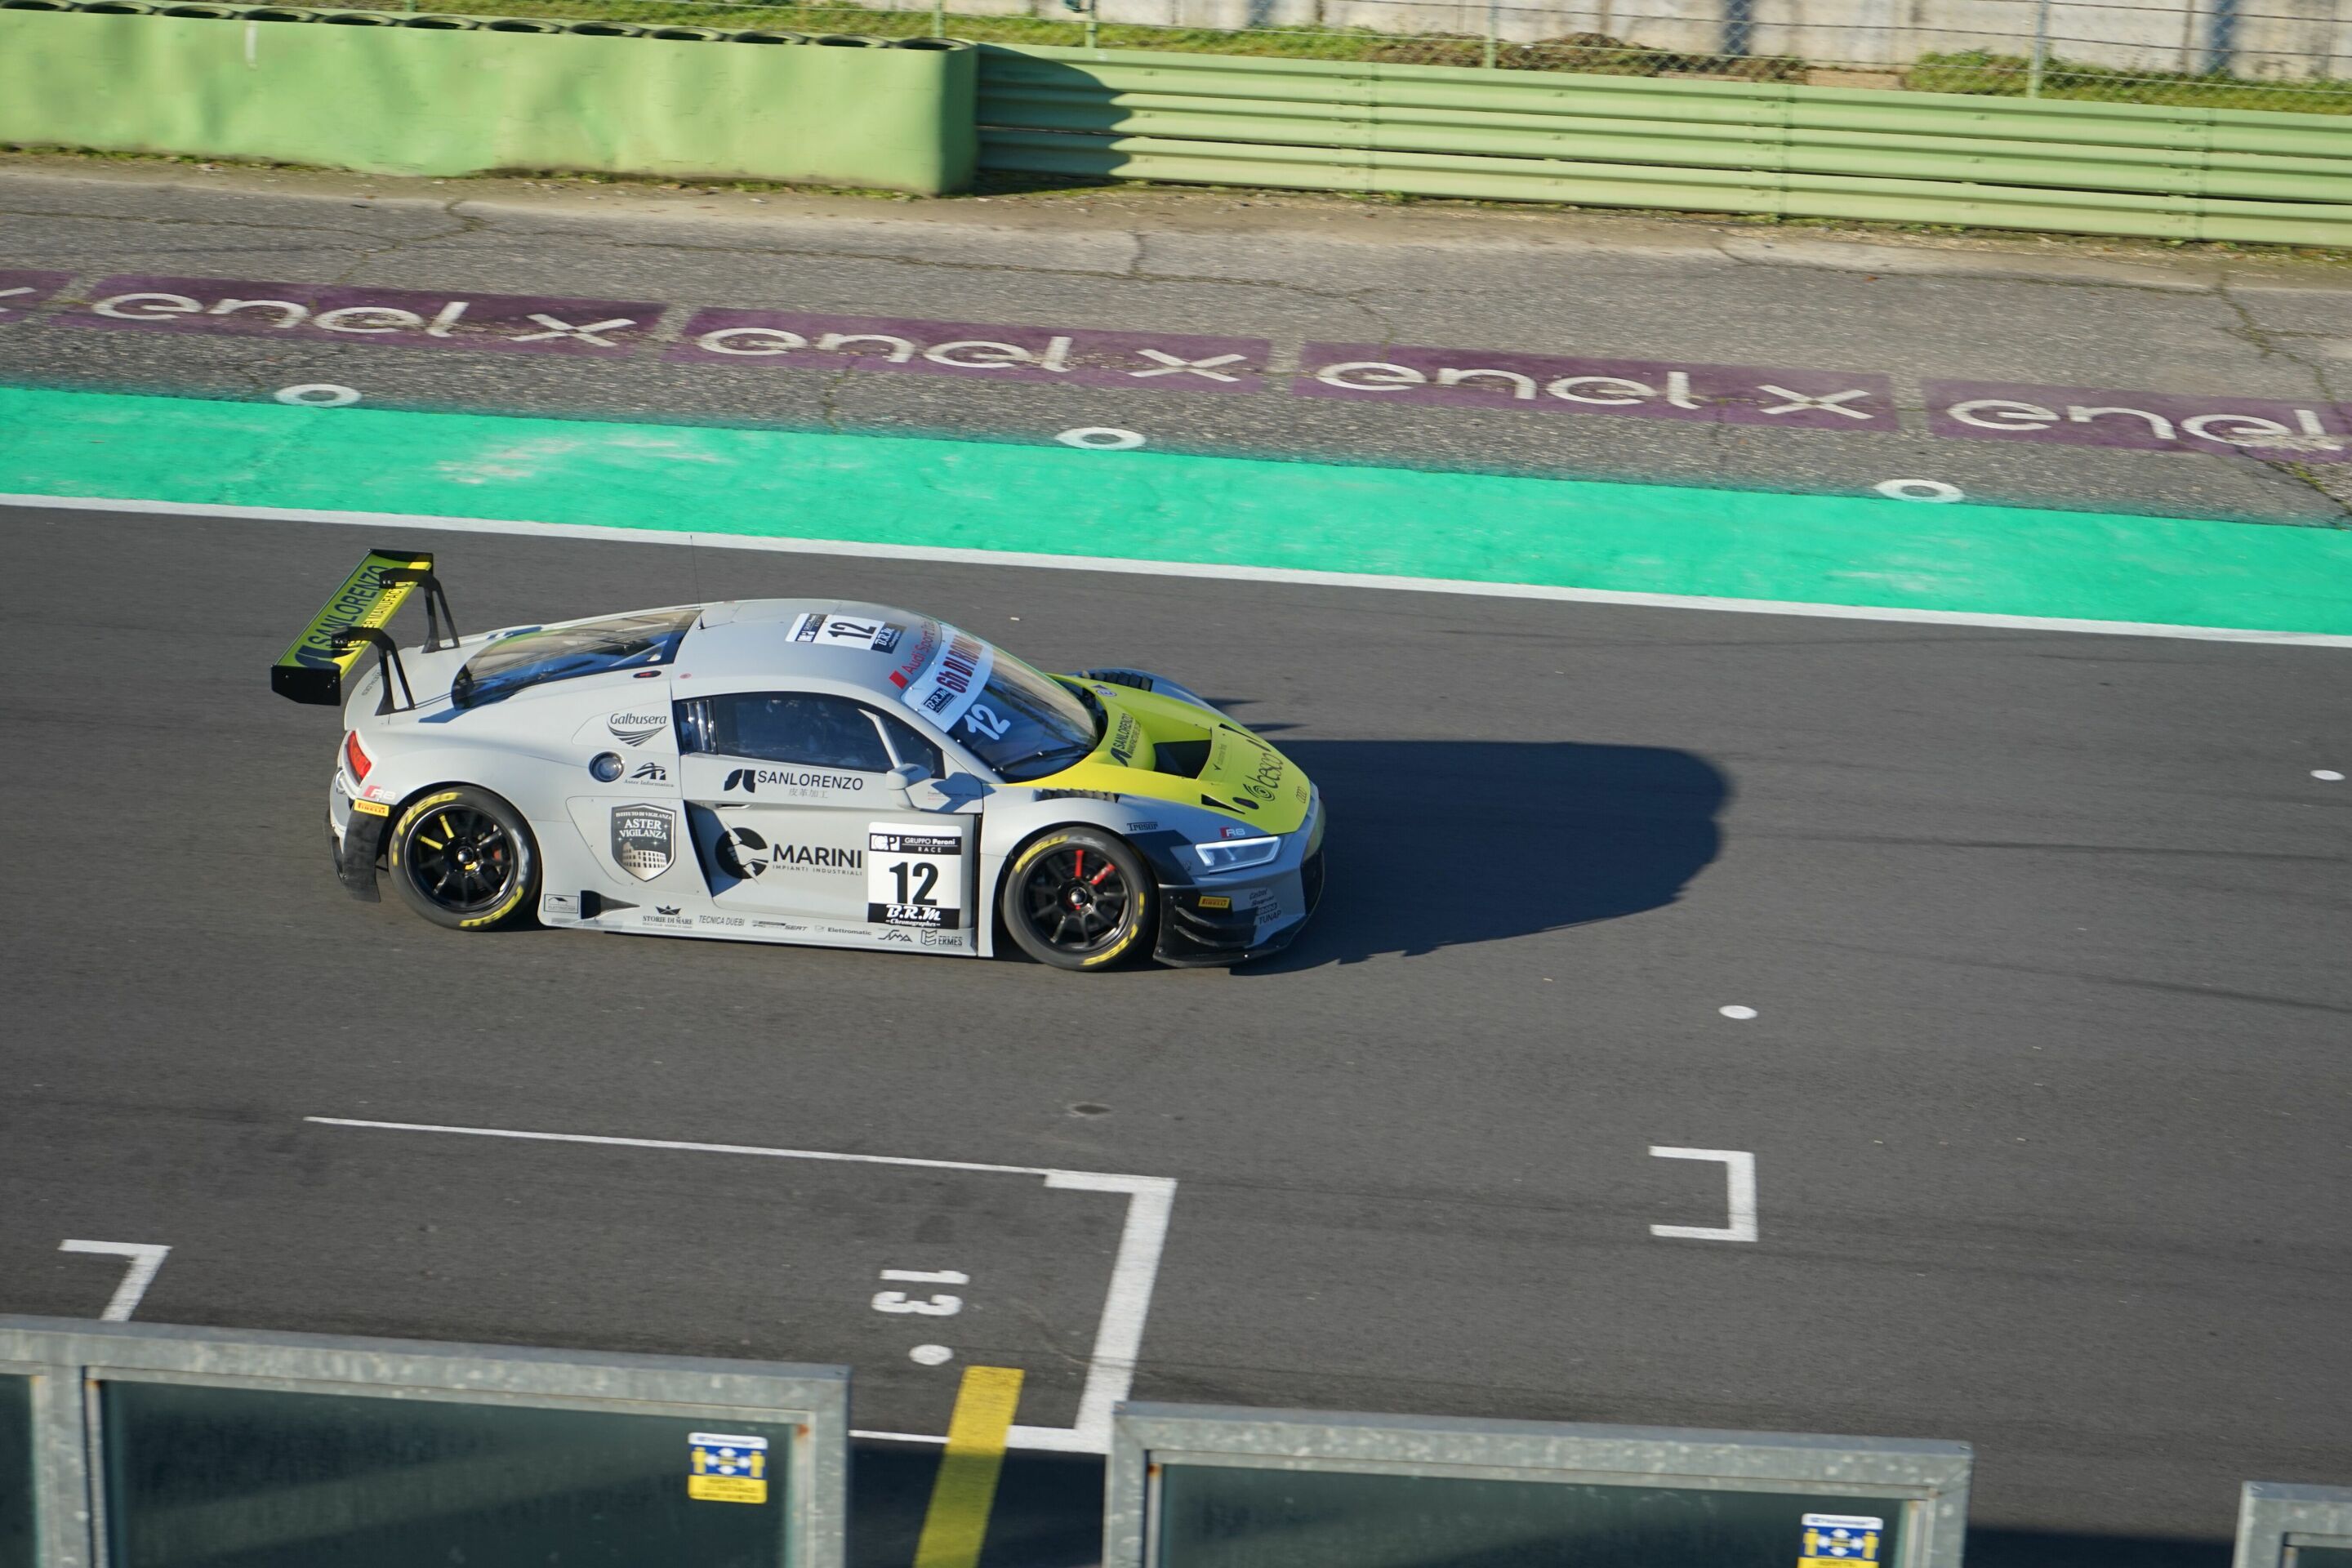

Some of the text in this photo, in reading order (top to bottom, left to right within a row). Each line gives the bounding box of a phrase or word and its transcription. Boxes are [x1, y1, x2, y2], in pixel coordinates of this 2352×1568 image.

[91, 292, 636, 348] enel x
[695, 327, 1248, 382] enel x
[1315, 361, 1875, 420] enel x
[1947, 399, 2345, 451] enel
[827, 621, 878, 639] 12
[902, 649, 925, 675] Audi
[914, 631, 936, 654] Sport
[942, 656, 975, 678] DI
[936, 670, 970, 694] 6h
[924, 687, 949, 710] B.R.M
[610, 713, 667, 725] Galbusera
[964, 703, 1011, 741] 12
[1113, 712, 1134, 750] SANLORENZO
[639, 779, 675, 788] Informatica
[757, 770, 864, 791] SANLORENZO
[370, 788, 397, 800] R8
[788, 787, 829, 799] 皮革加工
[357, 802, 386, 815] PIRELLI
[644, 812, 673, 821] VIGILANZA
[624, 818, 662, 831] ASTER
[1126, 822, 1159, 831] Tresor
[618, 829, 667, 840] VIGILANZA
[1225, 828, 1245, 837] R8
[904, 837, 931, 845] GRUPPO
[773, 843, 862, 869] MARINI
[772, 864, 863, 876] IMPIANTI INDUSTRIALI
[889, 862, 939, 906] 12
[642, 915, 667, 923] STORIE
[676, 917, 693, 925] MARE
[885, 904, 942, 921] B.R.M
[698, 915, 725, 925] TECNICA
[726, 917, 746, 926] DUEBI
[827, 927, 873, 937] Elettromatic
[938, 936, 963, 947] ERMES
[871, 1269, 971, 1316] 13
